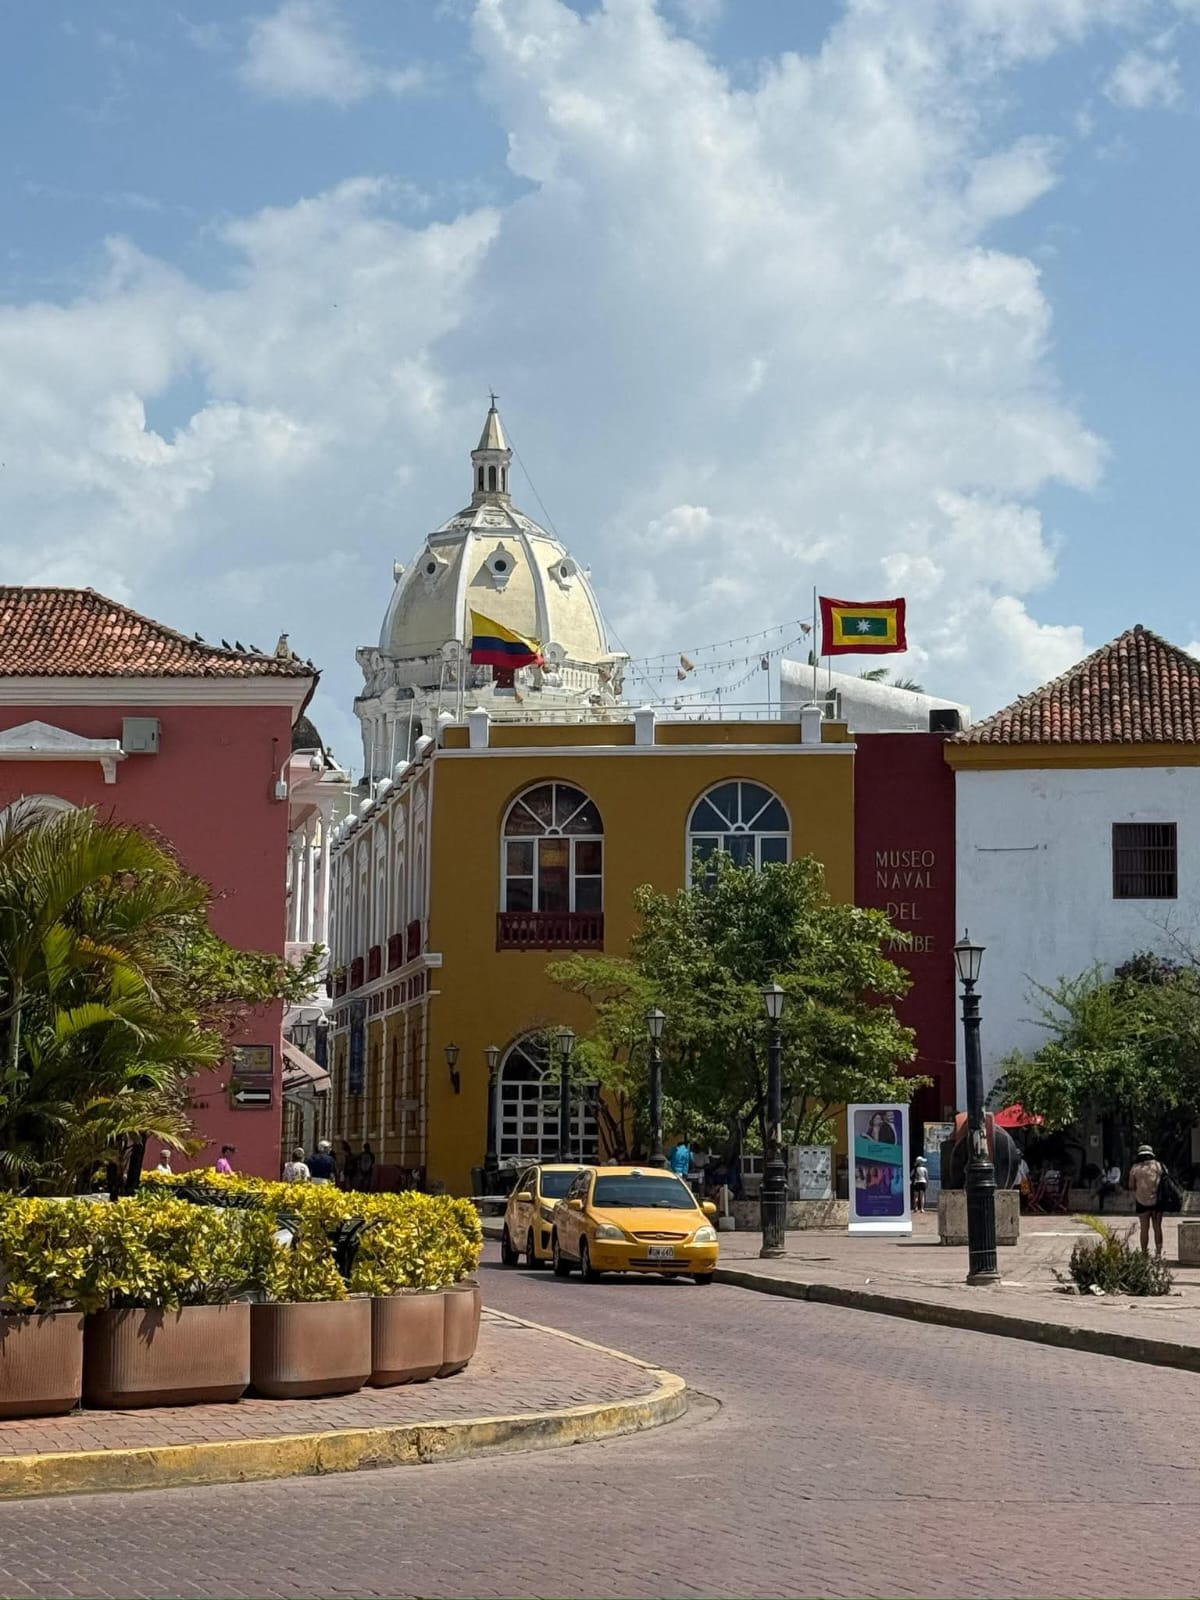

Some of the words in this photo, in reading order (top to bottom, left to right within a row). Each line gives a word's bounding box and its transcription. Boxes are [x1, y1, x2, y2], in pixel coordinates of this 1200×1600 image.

[876, 850, 935, 868] MUSEO
[876, 871, 935, 888] NAVAL
[886, 902, 921, 920] DEL
